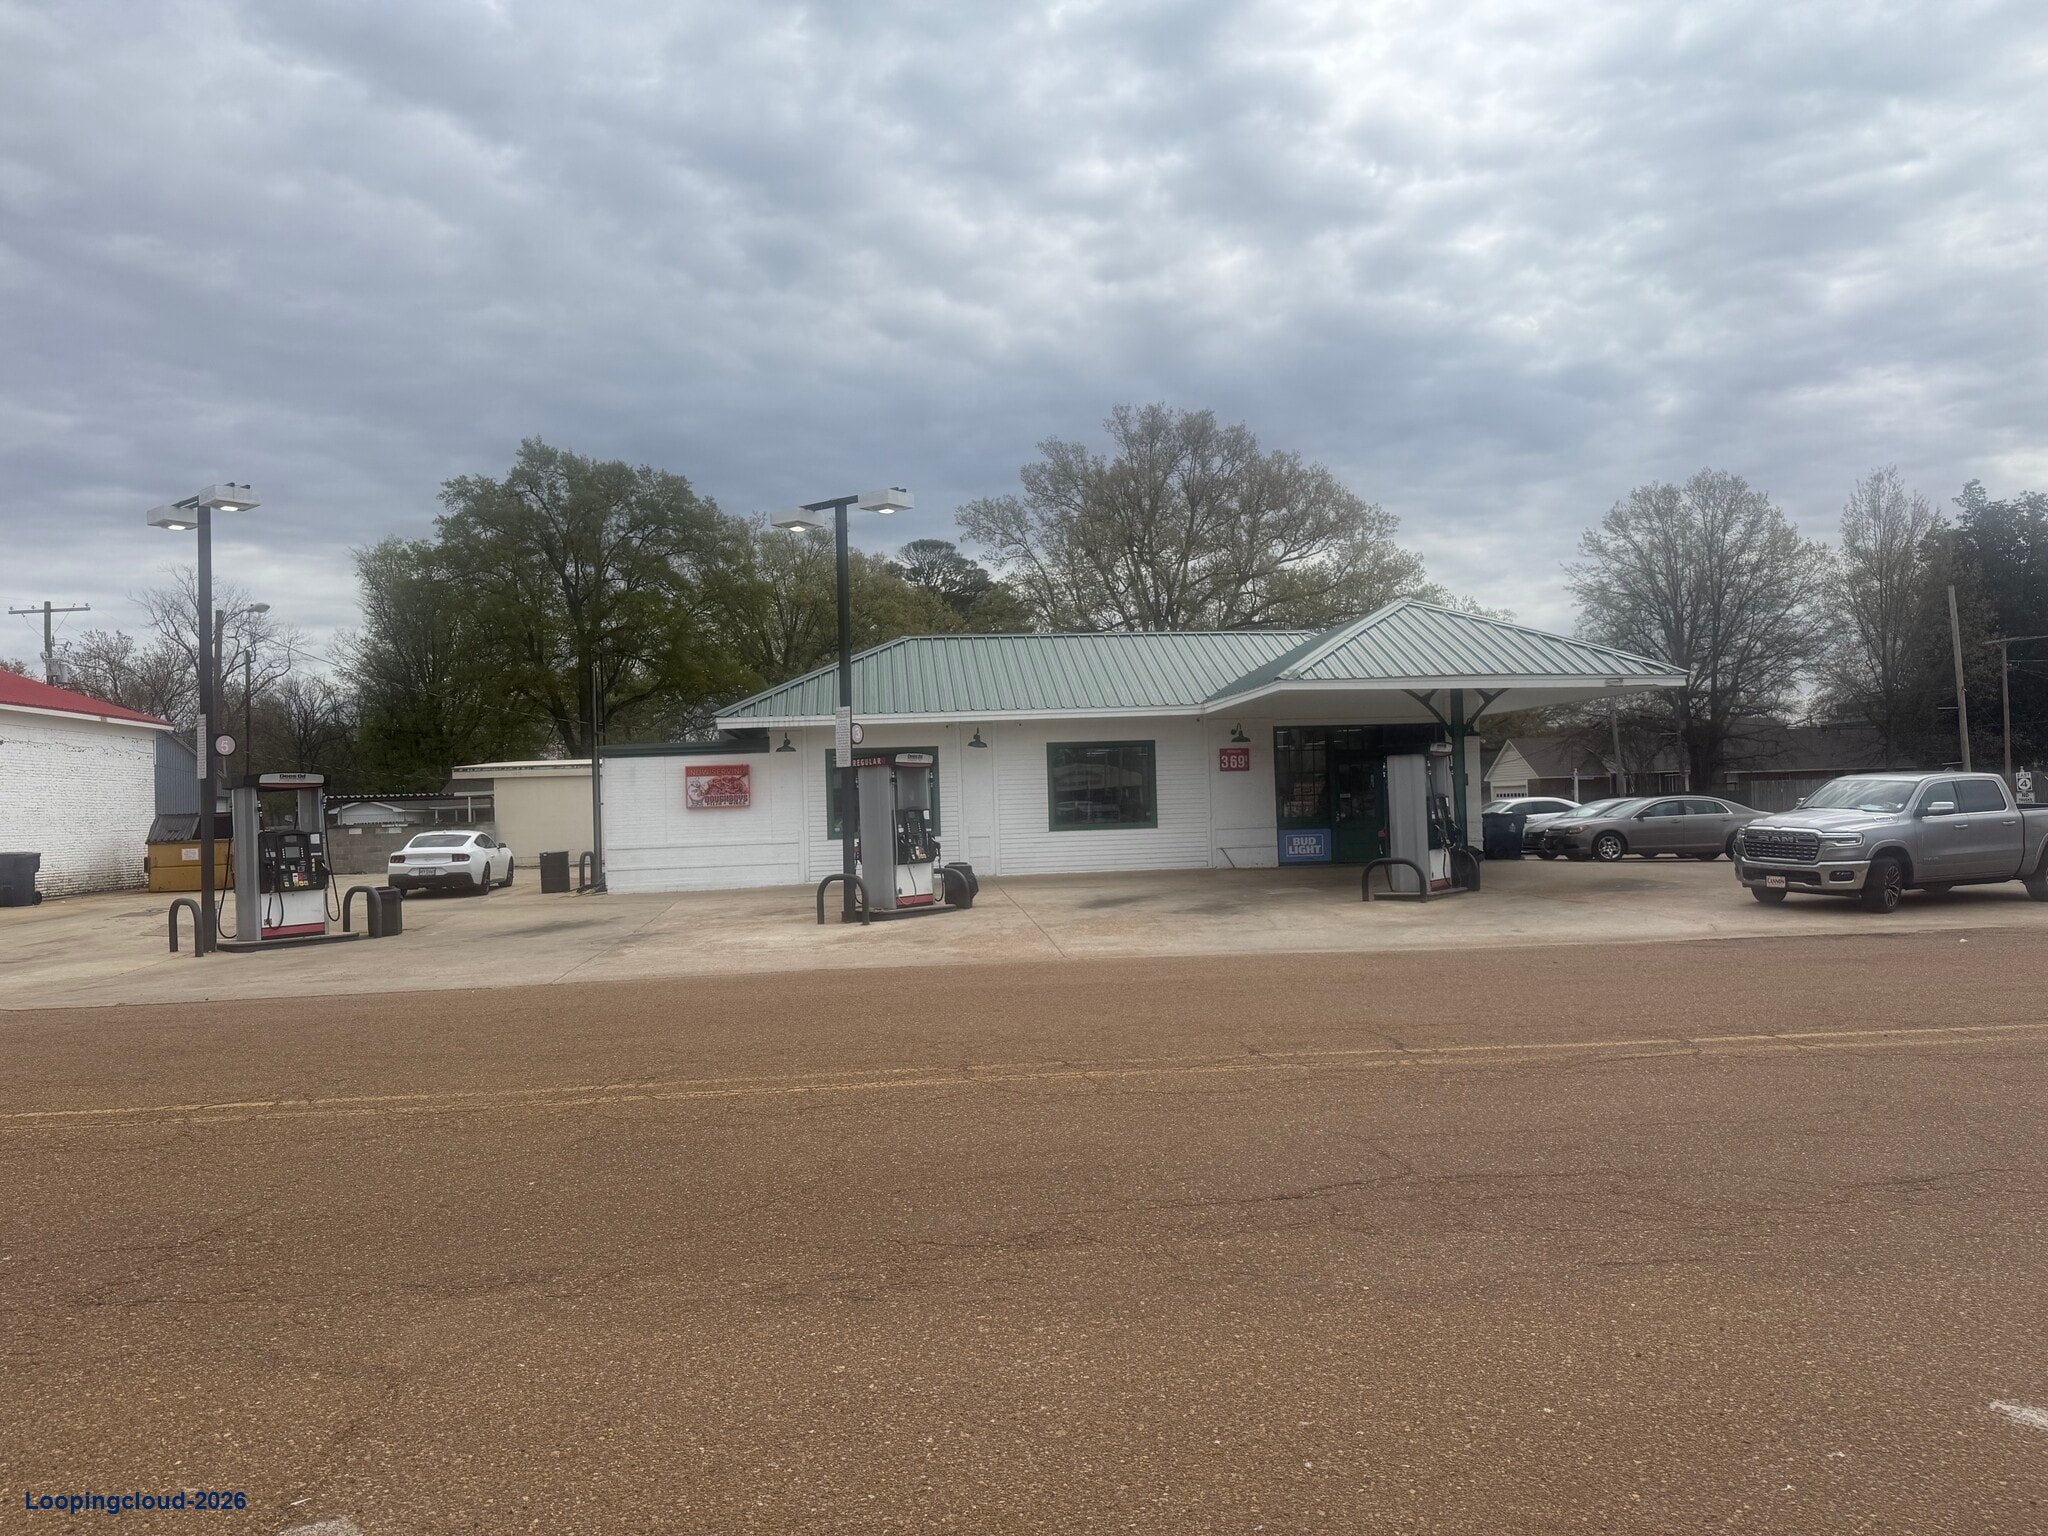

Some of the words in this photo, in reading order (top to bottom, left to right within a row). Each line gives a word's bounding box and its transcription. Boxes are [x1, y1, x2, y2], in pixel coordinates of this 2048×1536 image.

[220, 740, 229, 751] 5
[853, 757, 882, 767] REGULAR
[690, 768, 709, 776] NOW
[711, 767, 746, 775] SERVING
[2020, 779, 2028, 787] 4
[704, 794, 748, 803] DOUGHBOYS
[1293, 836, 1317, 846] BUD
[1759, 835, 1797, 843] RAM
[1289, 845, 1321, 855] LIGHT
